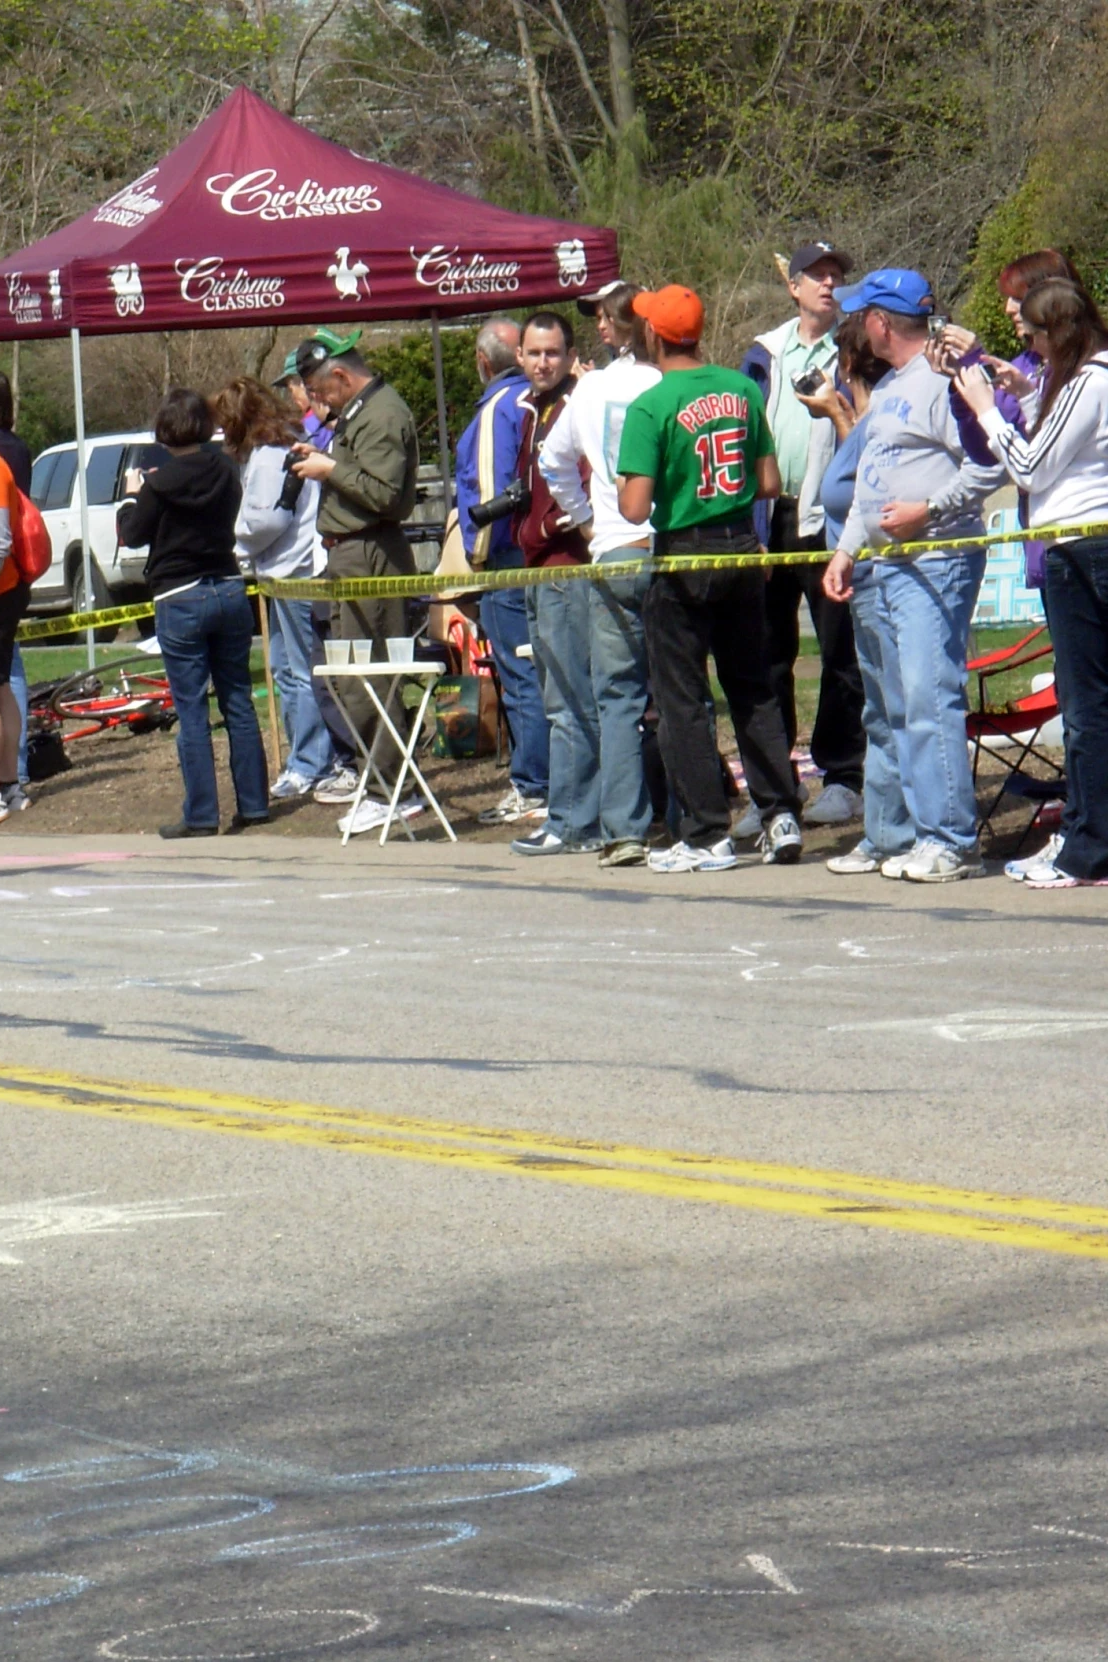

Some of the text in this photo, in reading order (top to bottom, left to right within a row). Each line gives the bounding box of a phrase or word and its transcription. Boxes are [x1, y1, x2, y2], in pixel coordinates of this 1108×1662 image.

[206, 168, 378, 216] Ciclismo
[259, 198, 382, 221] CLASSICO
[175, 256, 284, 302] Ciclismo
[410, 245, 521, 286] Ciclismo
[438, 277, 520, 296] CLASSICO
[202, 292, 285, 312] CLASSICO
[677, 391, 749, 434] PEDROIA
[695, 426, 748, 498] 15
